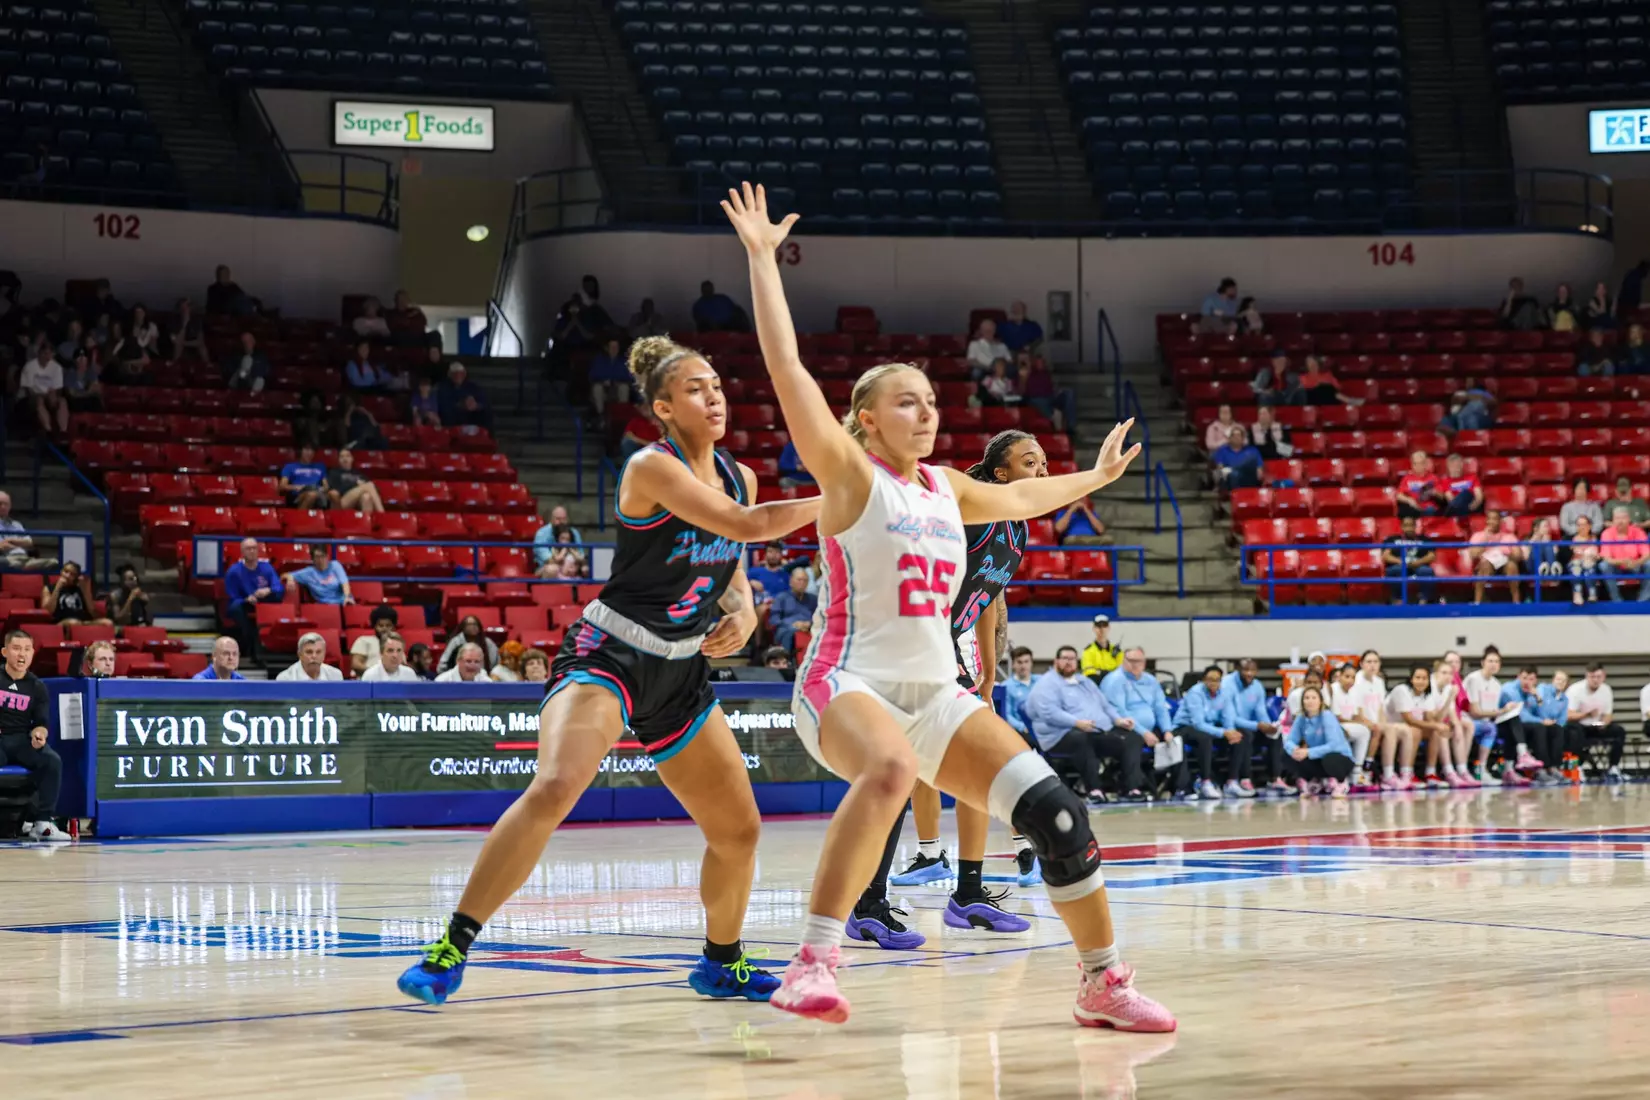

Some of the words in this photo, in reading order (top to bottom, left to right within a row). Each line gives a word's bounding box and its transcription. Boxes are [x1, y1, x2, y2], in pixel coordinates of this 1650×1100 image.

[343, 111, 403, 136] Super
[404, 110, 423, 142] 1
[423, 115, 484, 135] Foods
[93, 212, 141, 240] 102
[1366, 241, 1416, 267] 104
[667, 576, 715, 624] 5
[898, 553, 957, 618] 25
[953, 588, 991, 632] 15
[114, 710, 207, 746] Ivan
[221, 706, 340, 745] Smith
[377, 712, 419, 732] Your
[117, 753, 338, 778] FURNITURE
[429, 757, 480, 776] Official
[598, 755, 612, 773] of
[612, 755, 657, 773] Louisia
